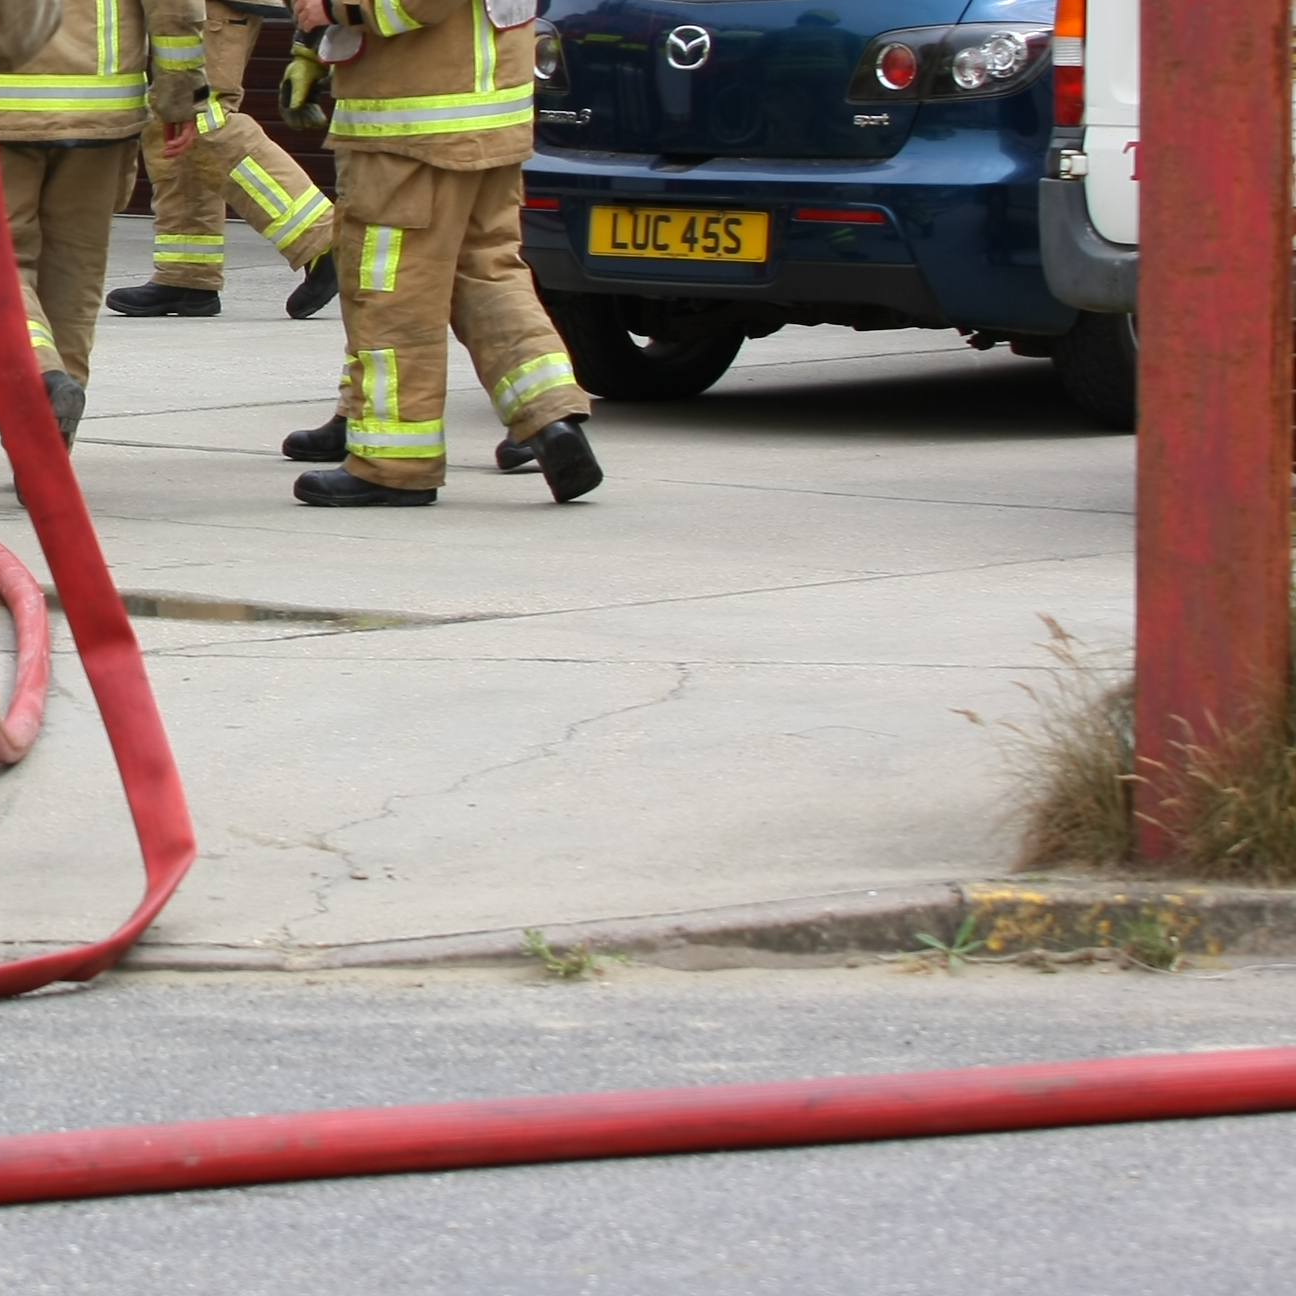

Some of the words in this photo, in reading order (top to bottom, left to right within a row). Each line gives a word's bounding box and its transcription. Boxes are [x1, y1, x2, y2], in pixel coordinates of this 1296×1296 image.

[853, 113, 890, 127] sport
[611, 212, 671, 251] LUC
[680, 216, 743, 255] 45S
